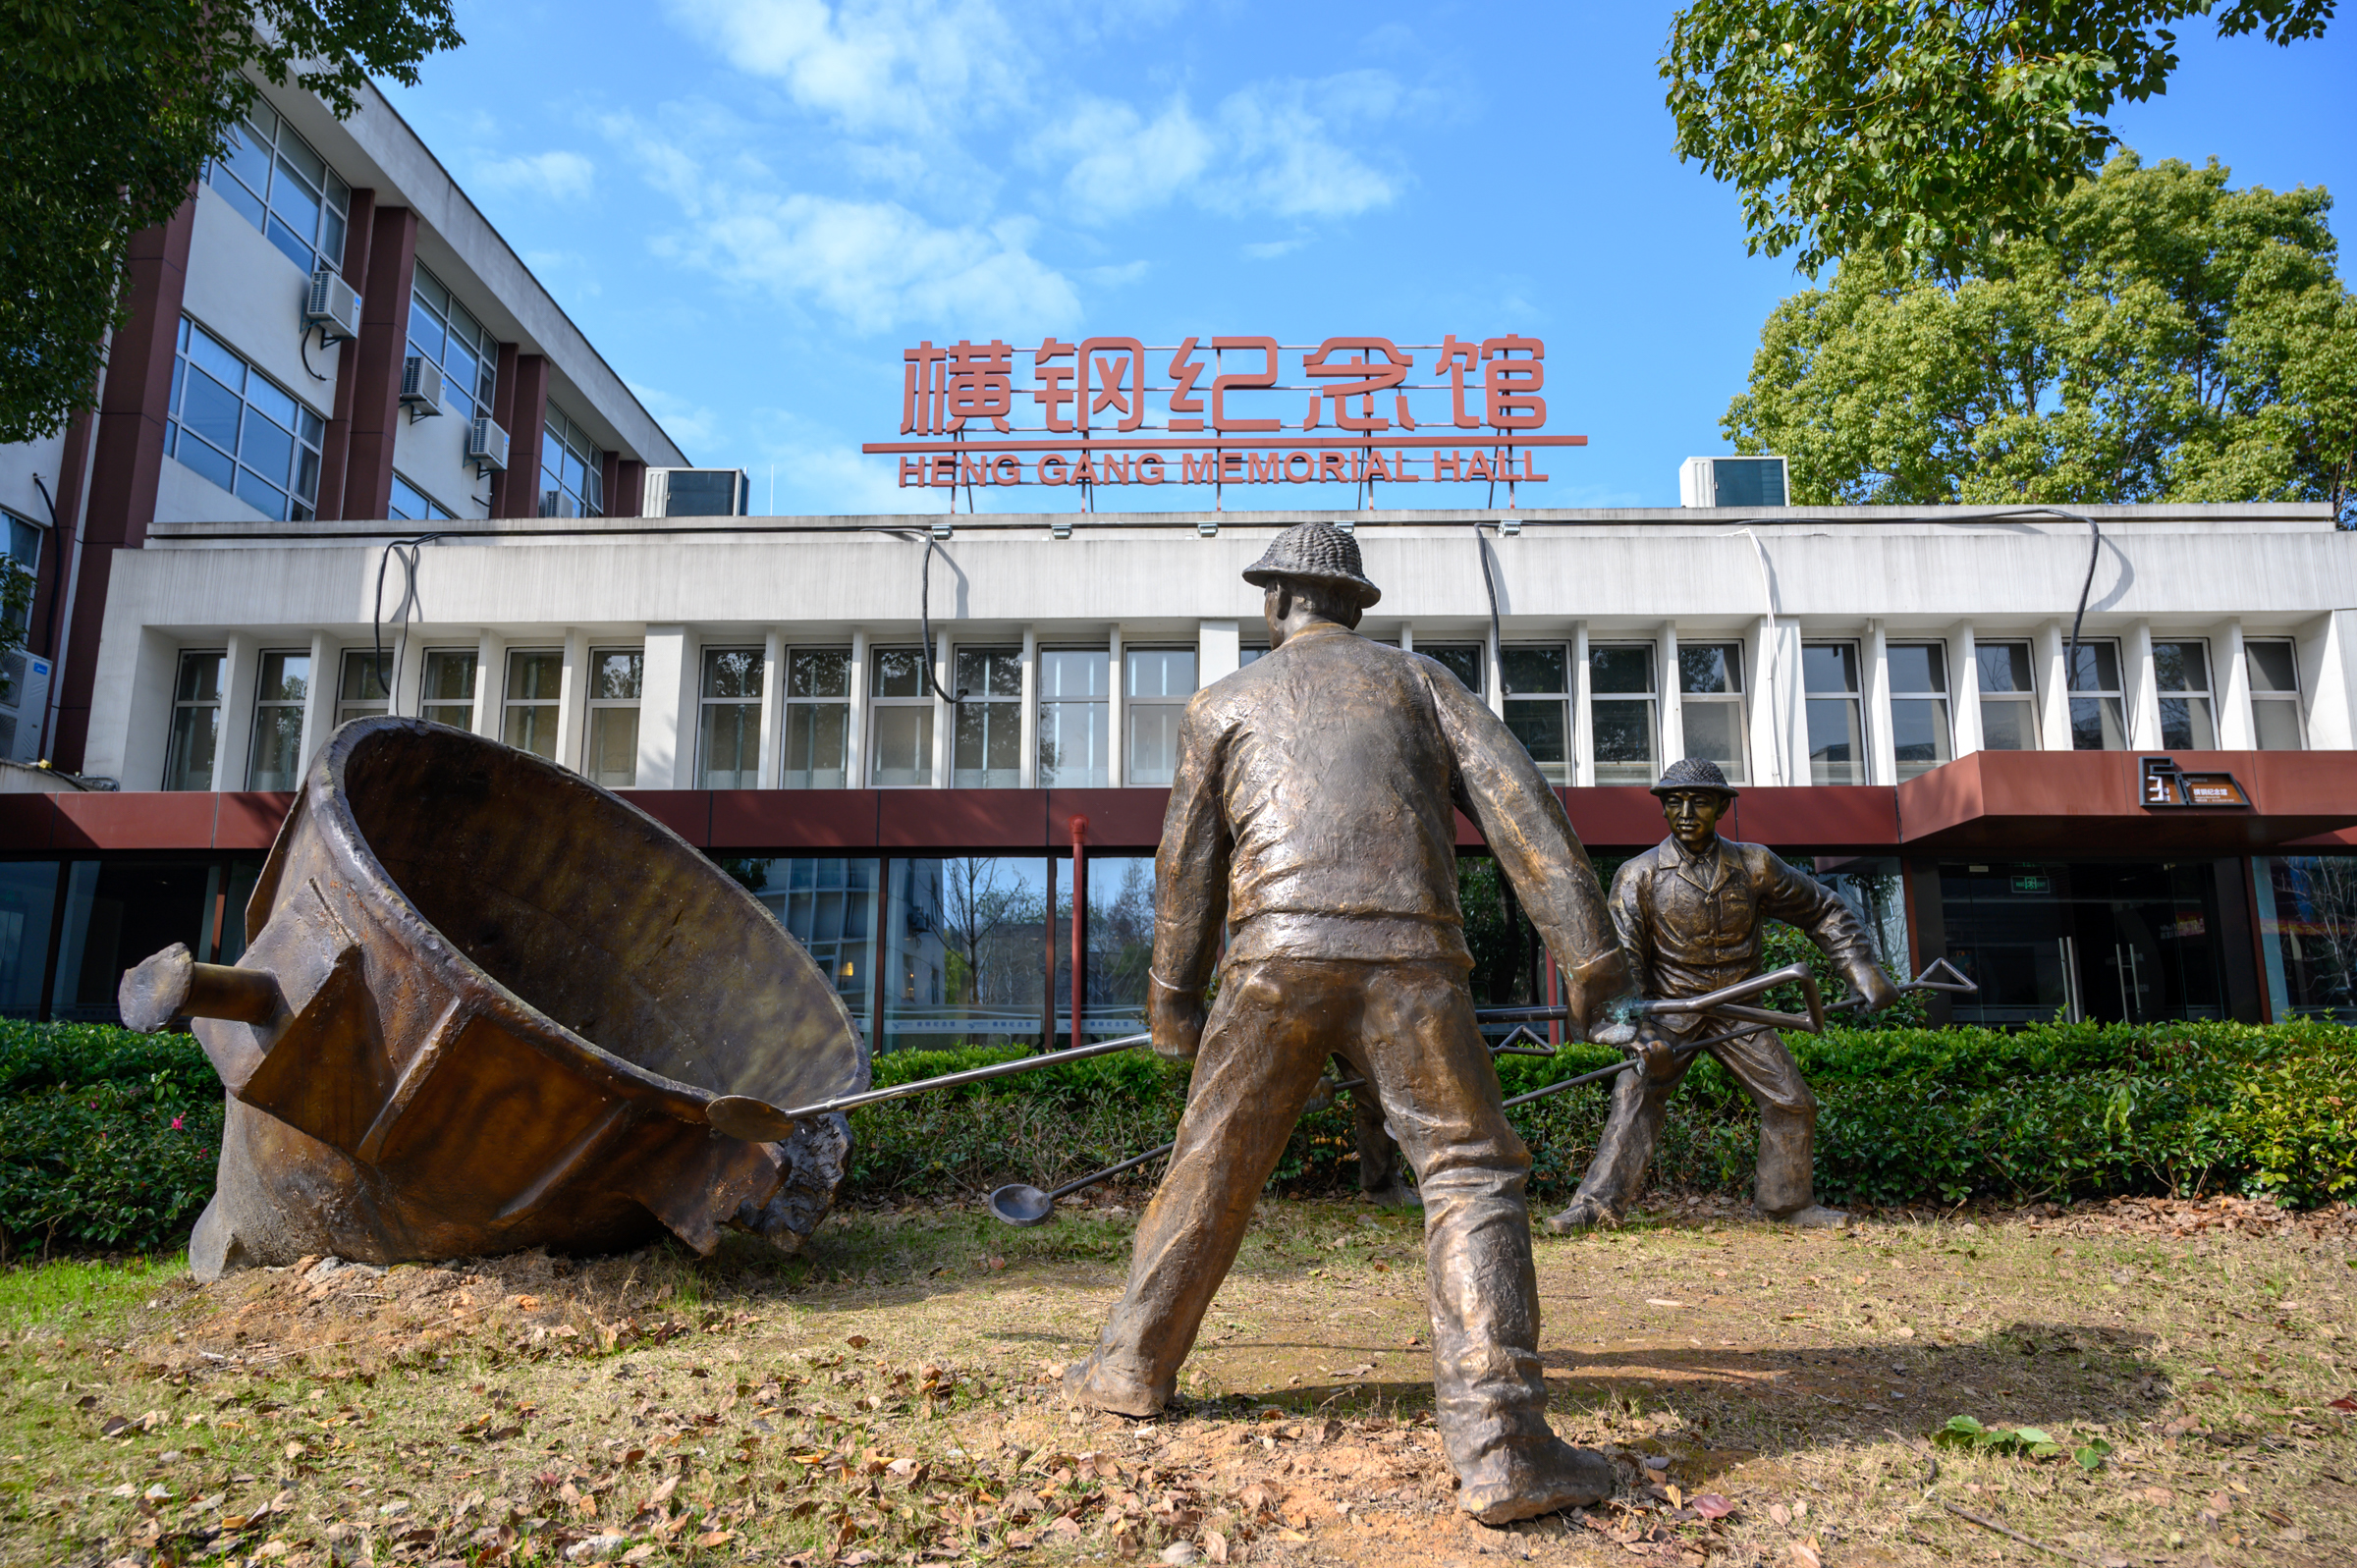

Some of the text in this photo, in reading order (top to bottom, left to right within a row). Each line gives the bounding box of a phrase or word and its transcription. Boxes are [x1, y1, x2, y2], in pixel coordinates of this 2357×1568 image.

[901, 335, 1547, 435] 横钢纪念馆
[899, 450, 1550, 488] HENG GANG MEMORIAL HALL
